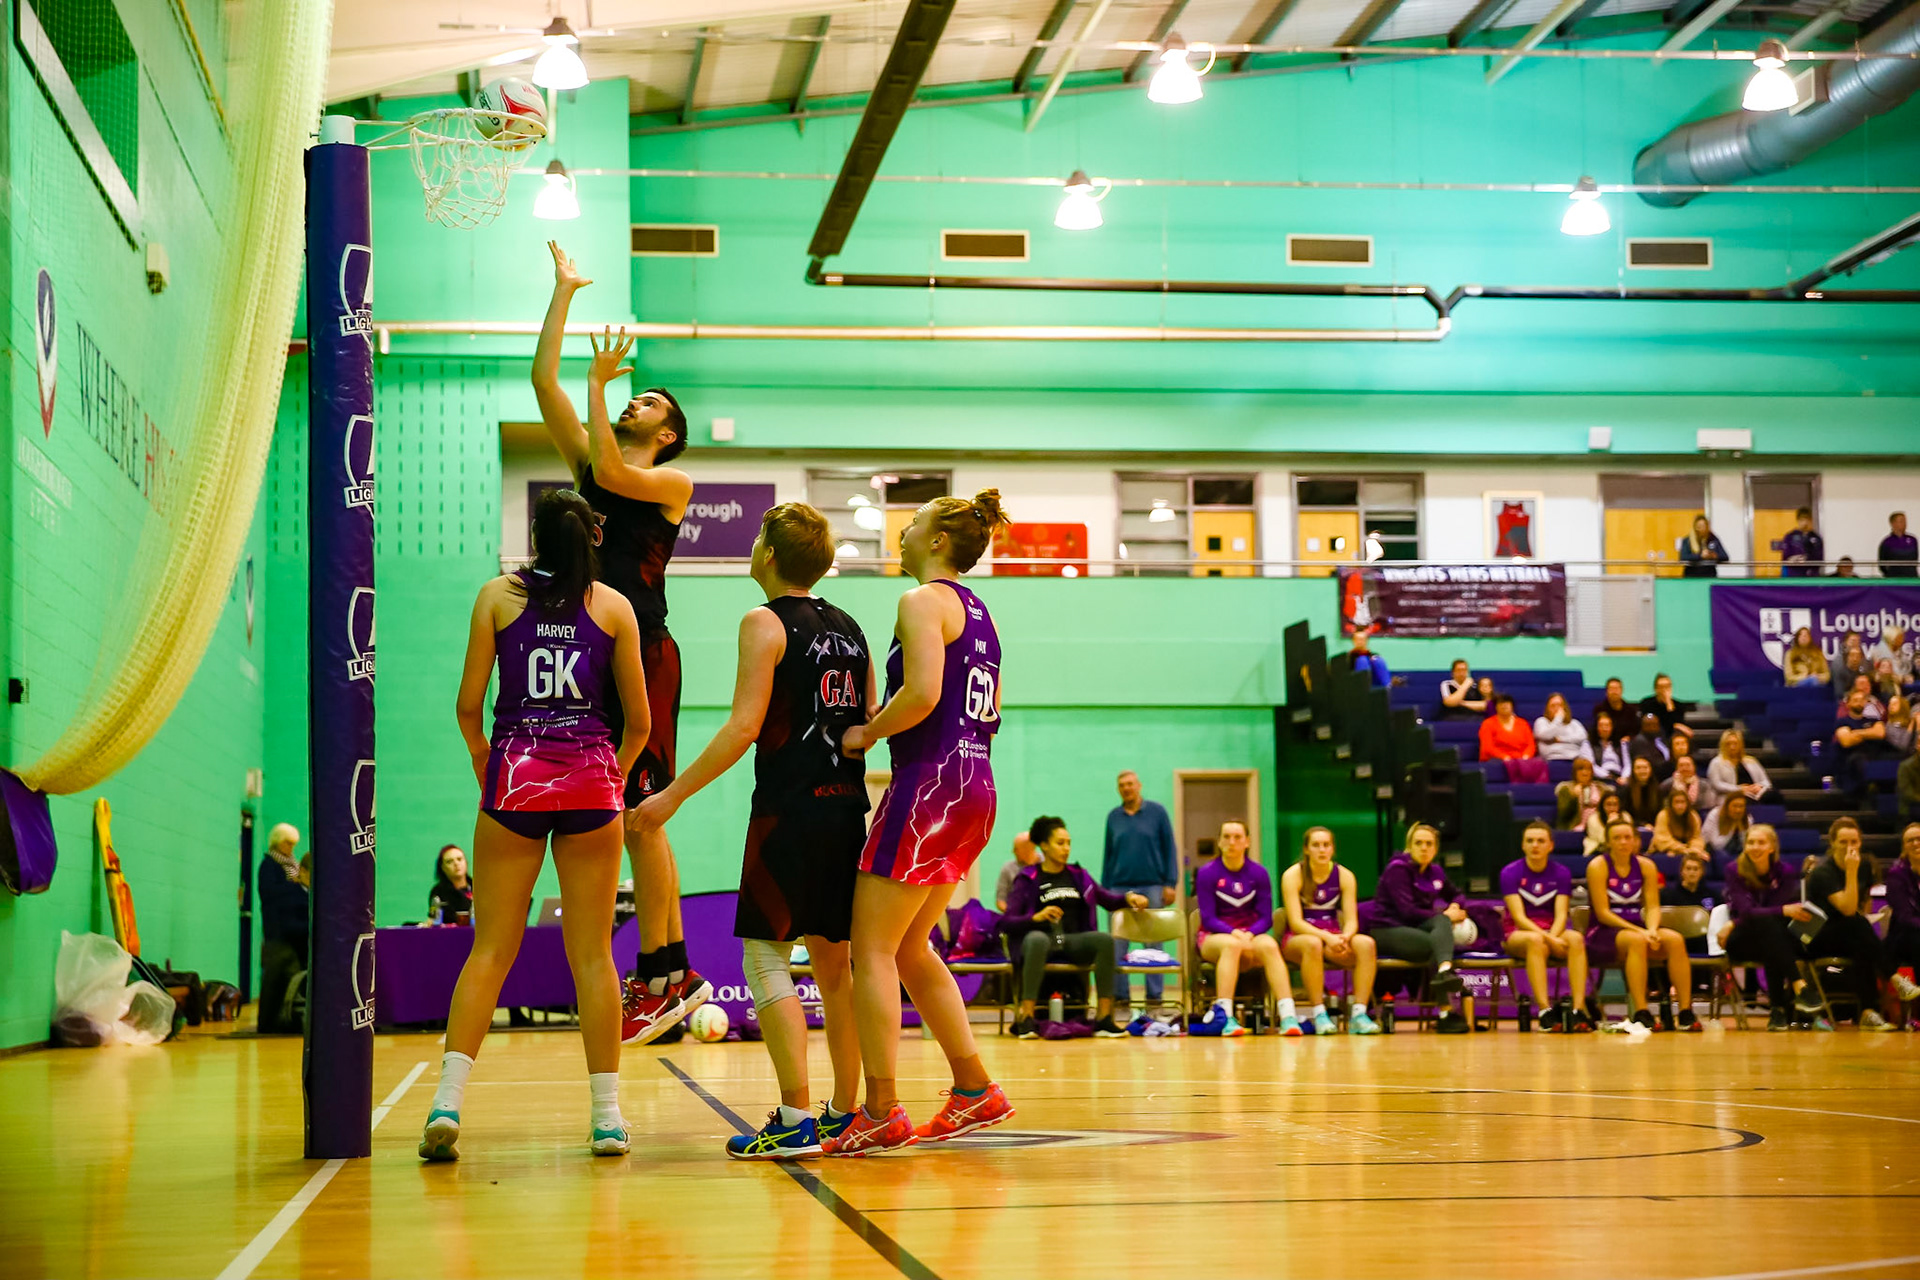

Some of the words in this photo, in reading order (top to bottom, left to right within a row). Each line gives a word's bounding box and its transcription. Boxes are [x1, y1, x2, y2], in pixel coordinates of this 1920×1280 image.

[77, 321, 140, 488] WHERE
[536, 623, 577, 639] HARVEY
[528, 647, 584, 699] GK
[820, 669, 859, 708] GA
[965, 666, 998, 723] GD
